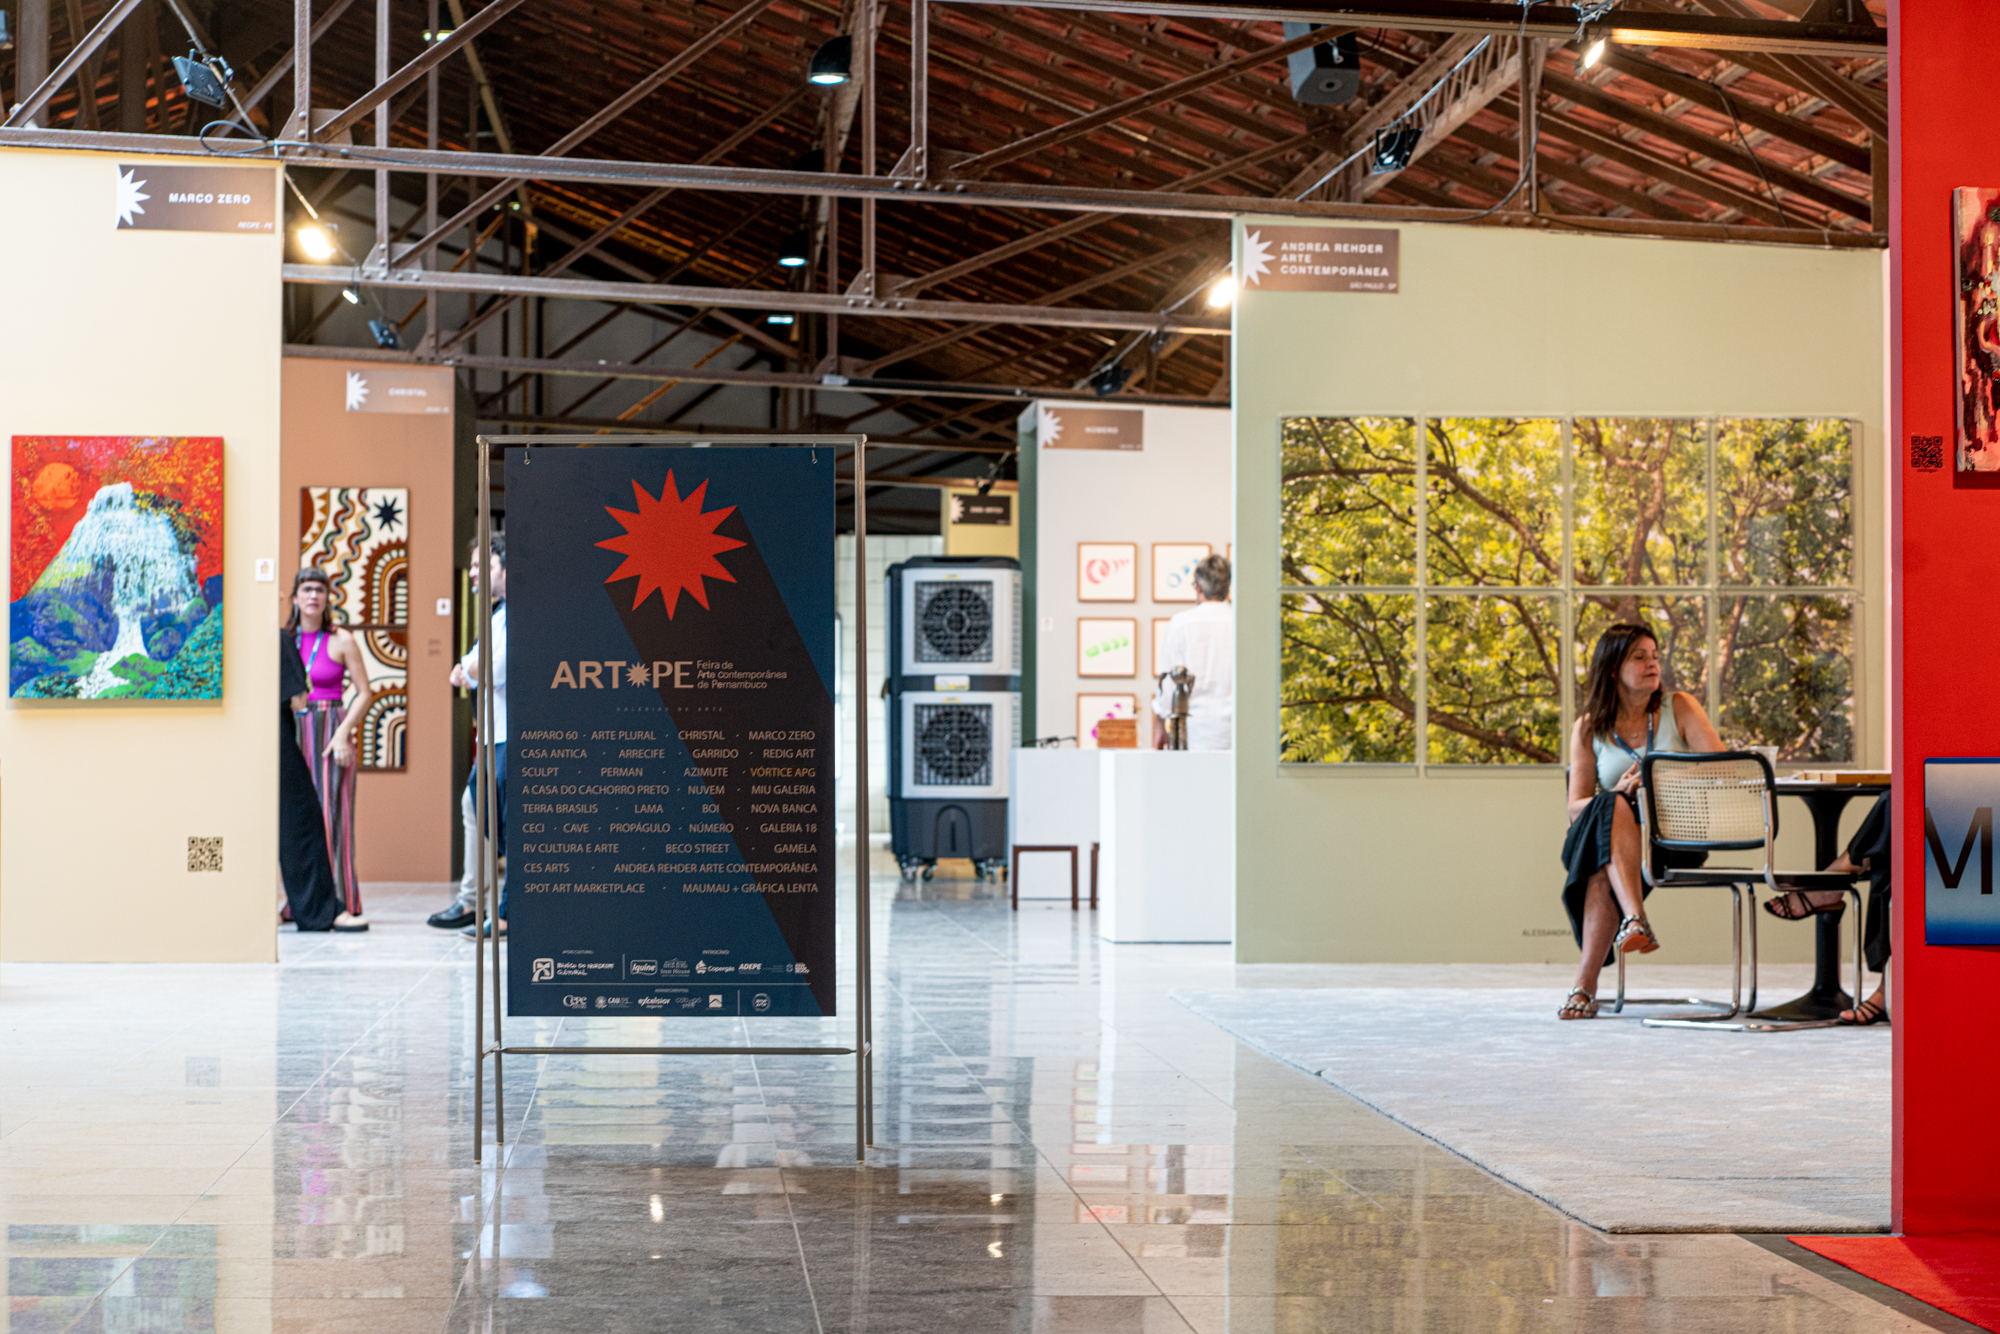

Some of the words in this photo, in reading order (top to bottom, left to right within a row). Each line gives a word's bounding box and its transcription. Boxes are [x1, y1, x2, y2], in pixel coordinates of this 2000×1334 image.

[169, 193, 214, 204] MARCO
[217, 194, 251, 205] ZERO
[1280, 242, 1330, 252] ANDREA
[1334, 243, 1384, 254] REHDER
[1280, 253, 1312, 263] ARTE
[1280, 264, 1389, 277] CONTEMPORÂNEA
[697, 660, 720, 669] Feira
[721, 661, 733, 669] de
[697, 670, 716, 679] Arte
[717, 669, 787, 680] contemporânea
[697, 681, 709, 689] de
[711, 679, 768, 689] Pernambuco
[520, 730, 564, 740] AMPARO
[565, 730, 578, 740] 60
[590, 730, 616, 740] ARTE
[618, 730, 656, 740] PLURAL
[678, 730, 725, 740] CHRISTAL
[748, 730, 786, 740] MARCO
[788, 730, 815, 740] ZERO
[520, 748, 548, 759] CASA
[550, 748, 587, 759] ANTICA
[618, 748, 665, 759] ARRECIFE
[692, 748, 739, 759] GARRIDO
[763, 748, 793, 759] REDIG
[795, 748, 816, 759] ART
[521, 767, 559, 777] SCULPT
[600, 767, 643, 777] PERMAN
[683, 767, 729, 777] AZIMUTE
[750, 766, 792, 777] VÓRTICE
[794, 767, 816, 777] APG
[522, 785, 529, 795] A
[531, 785, 558, 795] CASA
[560, 785, 577, 795] DO
[578, 785, 635, 795] CACHORRO
[637, 785, 669, 795] PRETO
[688, 785, 725, 795] NUVEM
[751, 785, 771, 795] MIU
[773, 785, 816, 795] GALERIA
[522, 803, 553, 814] TERRA
[555, 803, 598, 814] BRASILIS
[634, 803, 664, 814] LAMA
[702, 803, 720, 814] BOI
[751, 803, 780, 814] NOVA
[782, 803, 817, 814] BANCA
[522, 823, 545, 833] CECI
[563, 823, 589, 833] CAVE
[609, 822, 671, 833] PROPÁGULO
[689, 822, 734, 833] NÚMERO
[760, 823, 802, 833] GALERIA
[805, 823, 817, 833] 18
[523, 843, 537, 853] RV
[538, 843, 584, 853] CULTURA
[586, 843, 592, 853] E
[593, 843, 619, 853] ARTE
[665, 843, 693, 853] BECO
[694, 843, 730, 853] STREET
[773, 843, 817, 853] GAMELA
[523, 863, 542, 873] CES
[544, 863, 570, 873] ARTS
[613, 863, 655, 873] ANDREA
[657, 863, 697, 873] REHDER
[699, 863, 724, 873] ARTE
[726, 862, 818, 873] CONTEMPORÂNEA
[524, 883, 550, 893] SPOT
[552, 883, 572, 893] ART
[574, 883, 645, 893] MARKETPLACE
[682, 883, 730, 893] MAUMAU
[732, 883, 740, 893] +
[741, 882, 785, 893] GRÁFICA
[786, 883, 818, 893] LENTA
